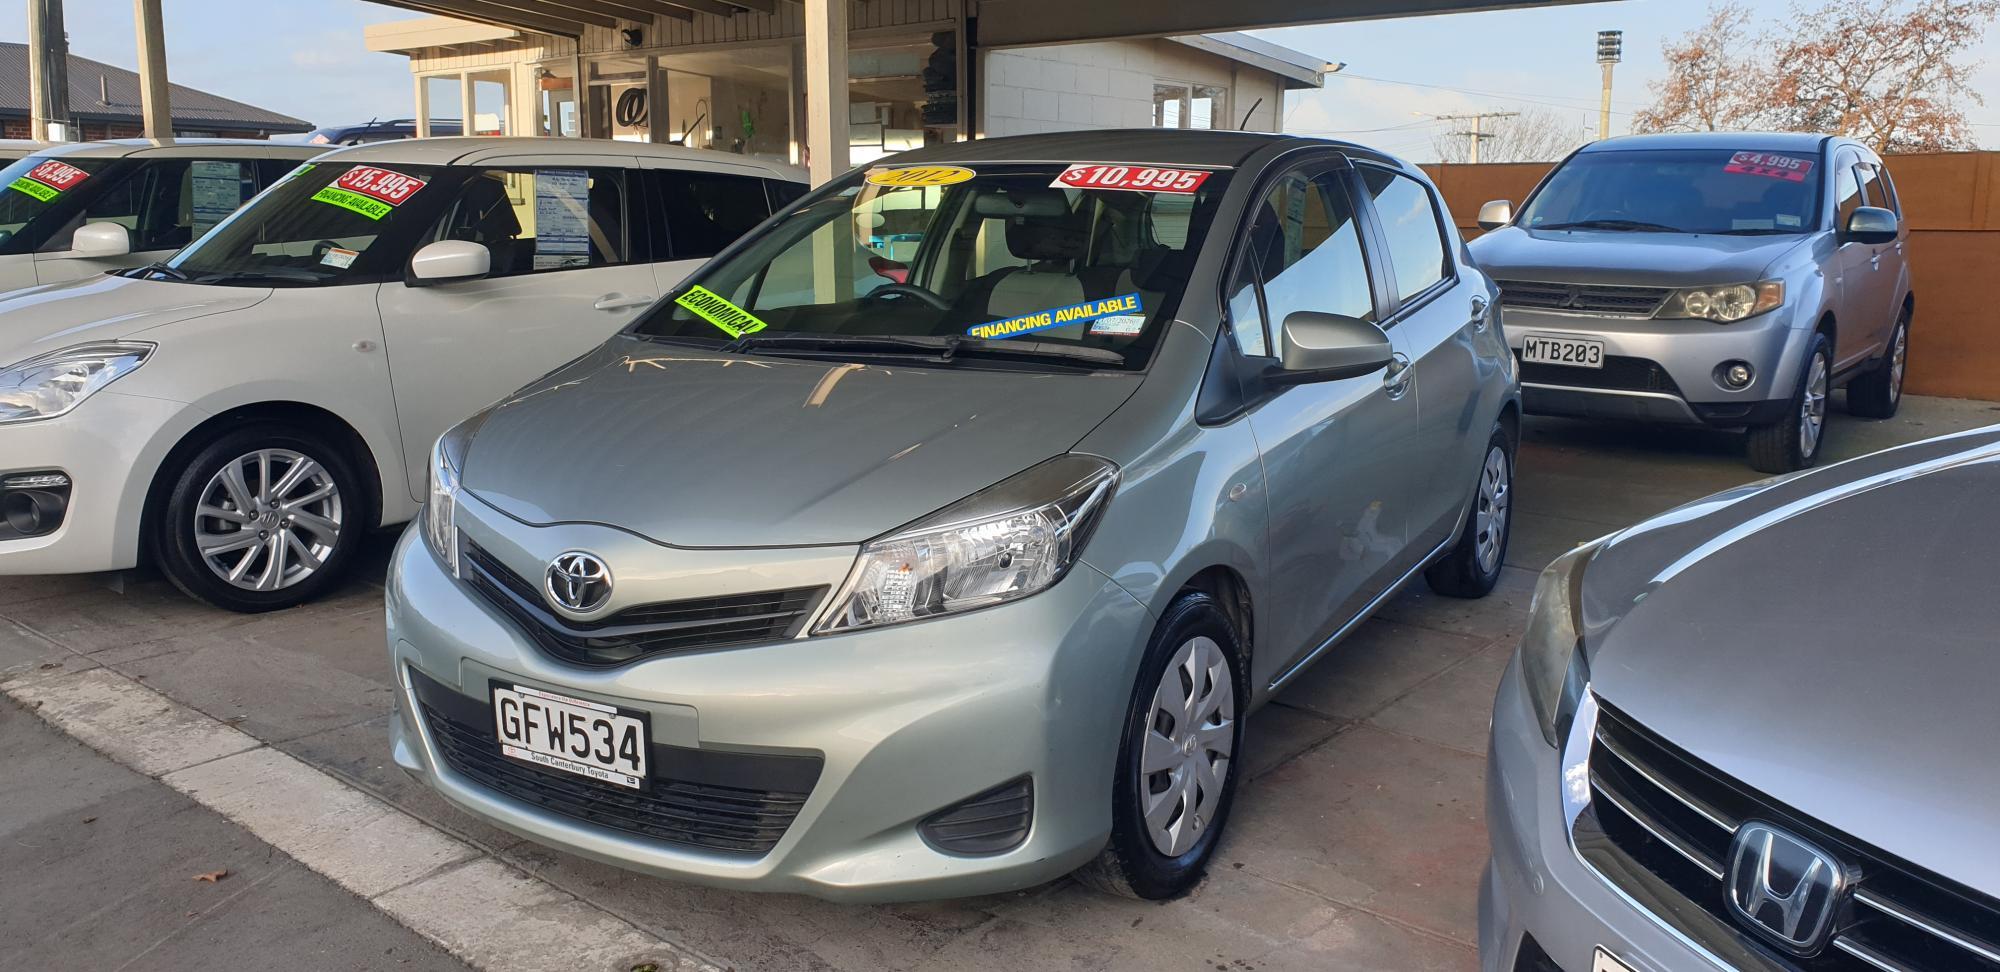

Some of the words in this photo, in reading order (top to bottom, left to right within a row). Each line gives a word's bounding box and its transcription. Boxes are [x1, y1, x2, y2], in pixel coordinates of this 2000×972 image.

[342, 168, 419, 199] $15,995
[878, 170, 961, 182] 2012
[1066, 166, 1202, 190] $10,995
[318, 189, 352, 205] FINANCING
[347, 197, 388, 217] AVAILABLE
[681, 289, 760, 333] ECONOMICAL
[971, 312, 1052, 339] FINANCING
[1055, 296, 1138, 323] AVAILABLE
[1525, 339, 1600, 364] MTB203
[500, 697, 641, 771] GFW534
[530, 752, 549, 764] South
[550, 757, 586, 774] Canterbury
[587, 766, 609, 780] Toyota
